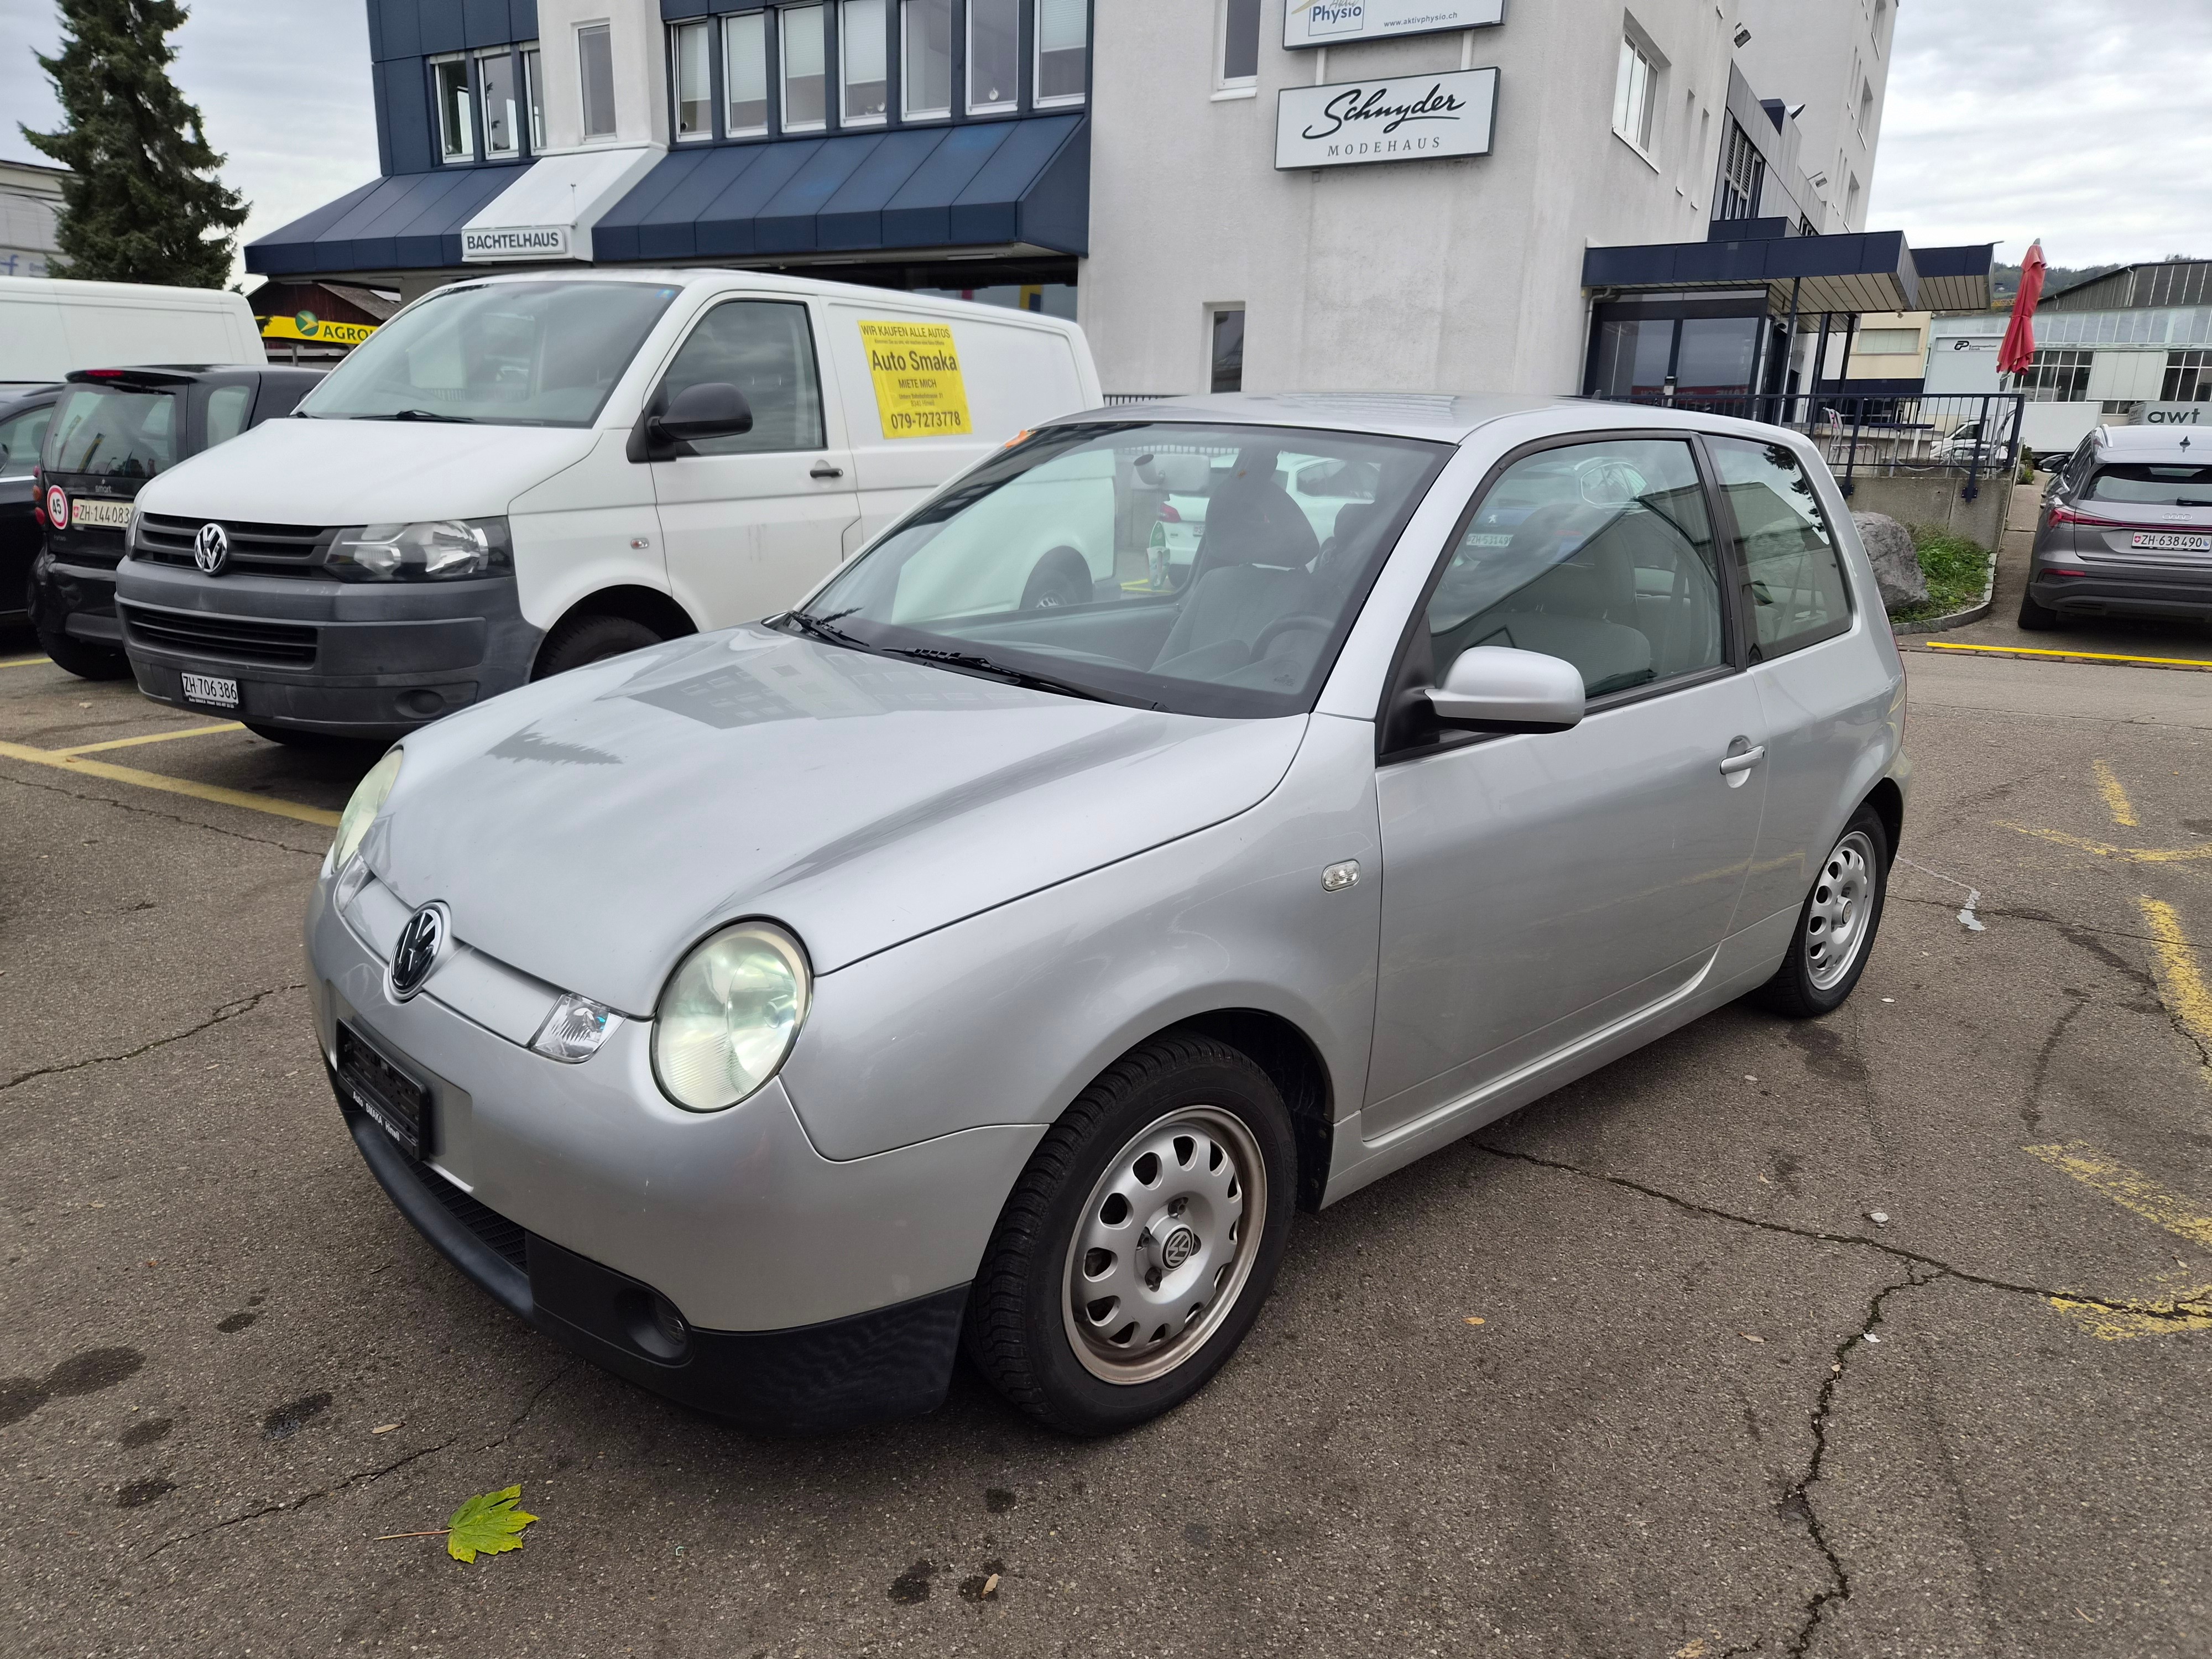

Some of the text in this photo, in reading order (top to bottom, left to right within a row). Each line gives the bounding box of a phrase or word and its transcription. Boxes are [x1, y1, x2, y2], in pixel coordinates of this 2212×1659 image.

[1312, 5, 1361, 24] Physio
[1384, 12, 1457, 27] www.aktivphysio.ch
[1302, 83, 1466, 139] Schnyder
[1327, 137, 1440, 156] MODEHAUS
[467, 232, 559, 249] BACHTELHAUS
[323, 325, 373, 341] AGRO
[861, 325, 950, 338] WIR KAUFEN ALLE AUTOS
[872, 349, 957, 372] Auto Smaka
[898, 379, 937, 388] MIETE MICH
[891, 411, 961, 430] 079-7273778
[2147, 408, 2200, 424] awt
[52, 499, 61, 515] 45
